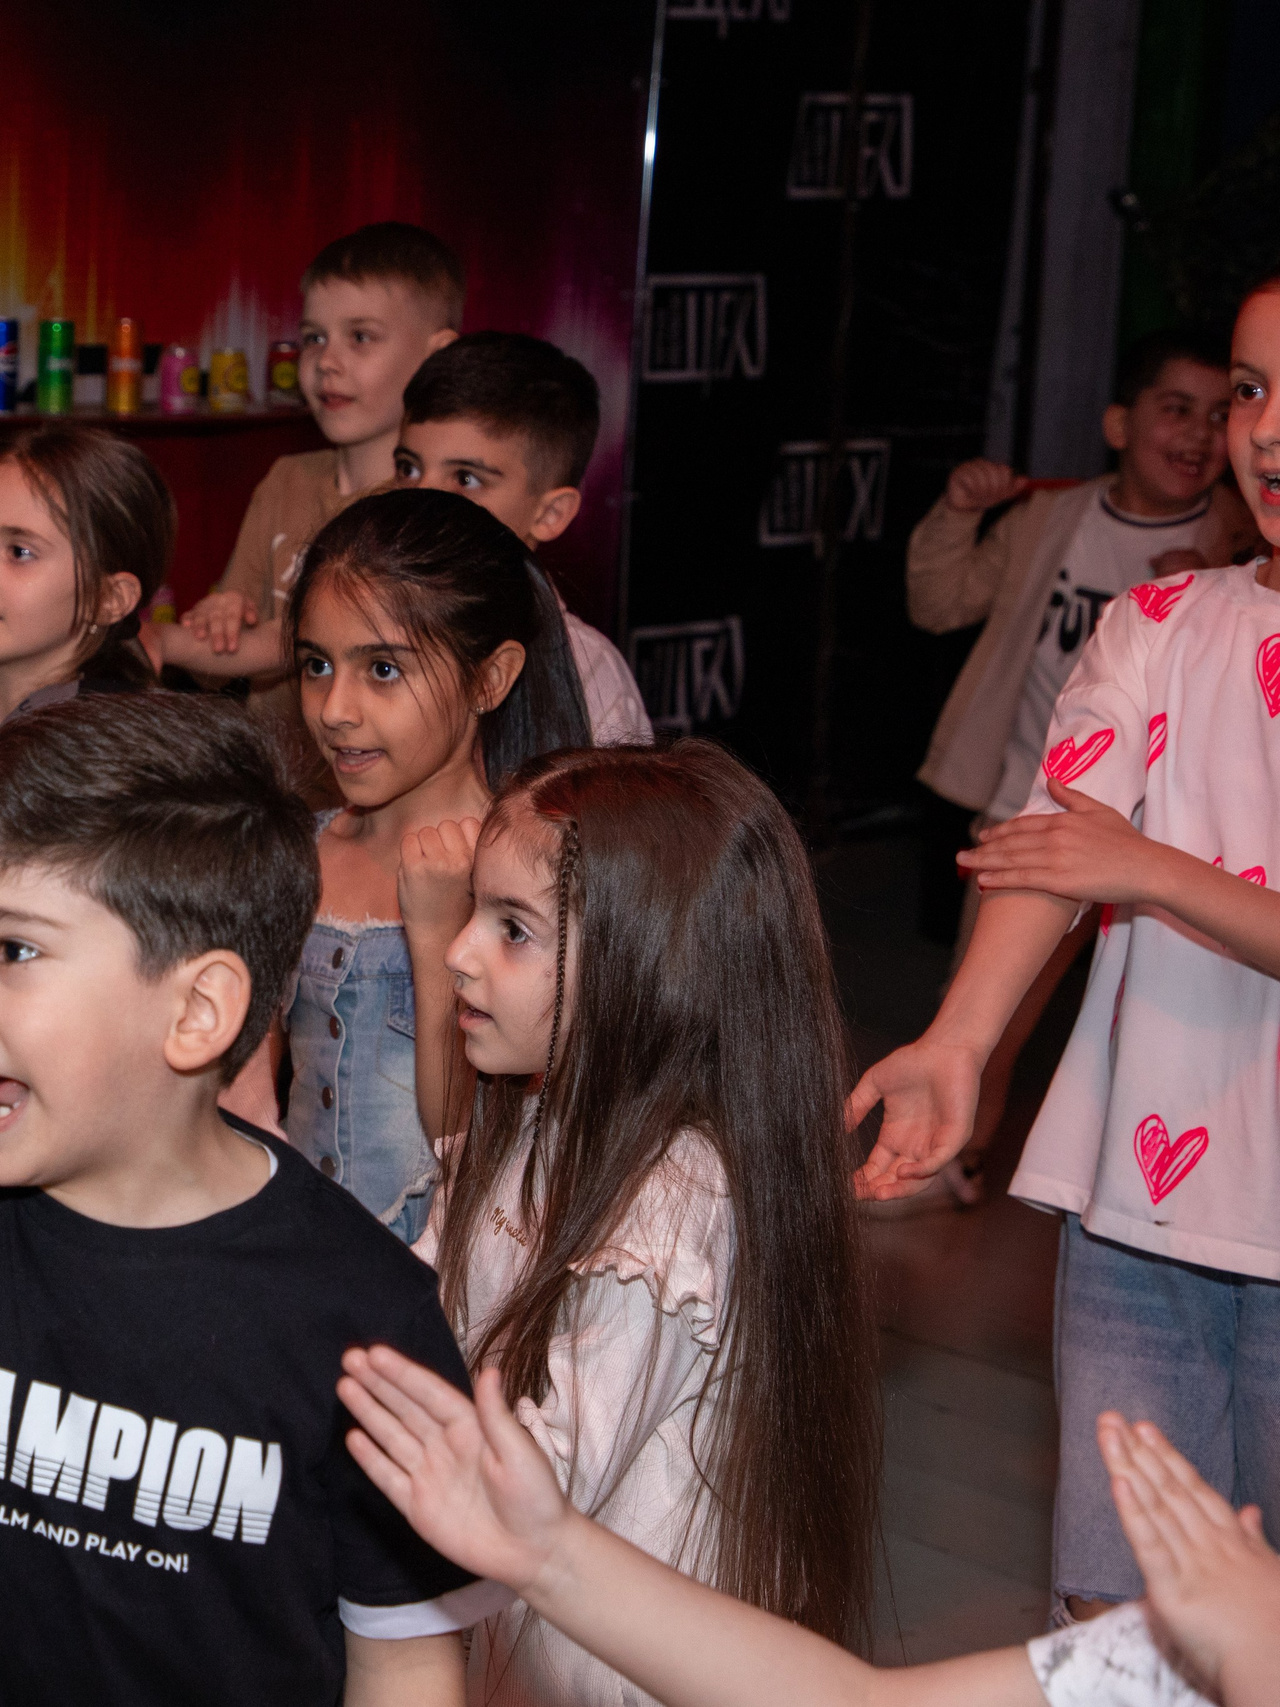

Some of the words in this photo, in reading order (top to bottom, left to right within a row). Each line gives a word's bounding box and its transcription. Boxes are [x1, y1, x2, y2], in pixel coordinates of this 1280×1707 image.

[32, 1518, 80, 1548] AND
[84, 1532, 142, 1562] PLAY
[145, 1549, 189, 1574] ON!
